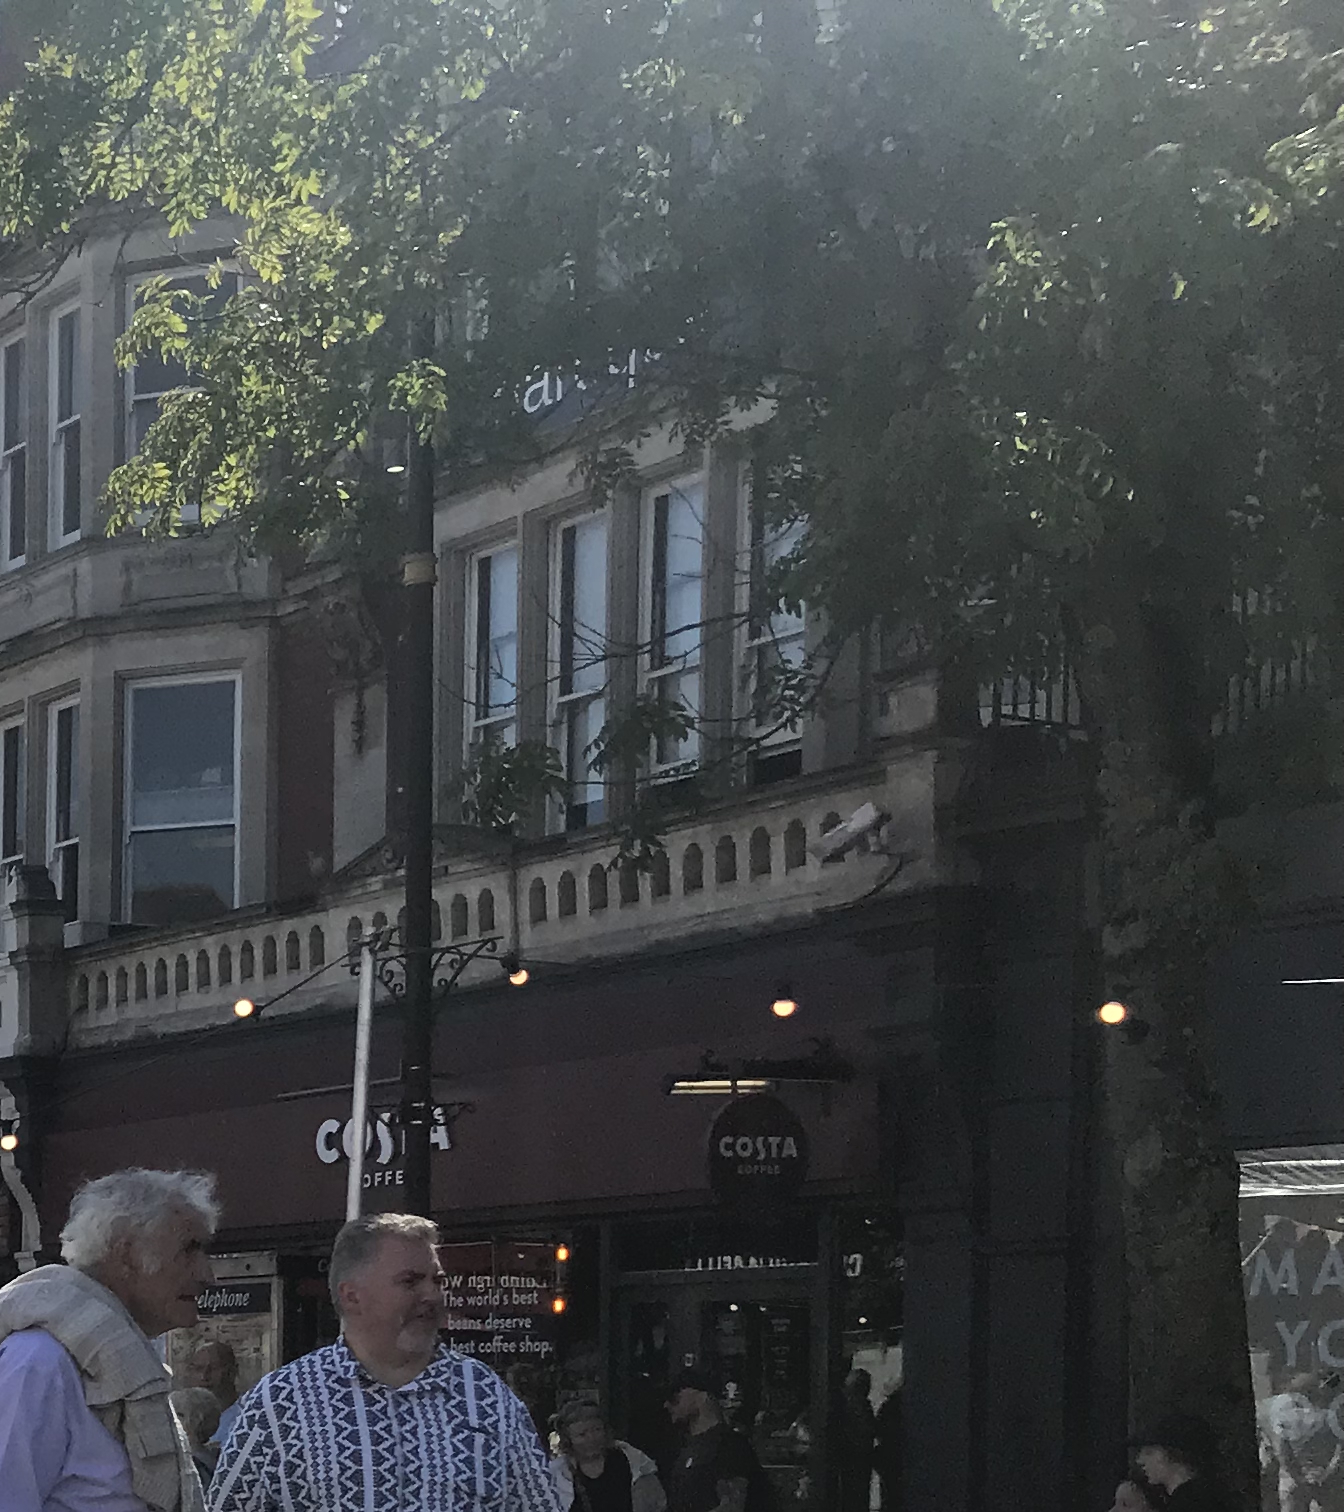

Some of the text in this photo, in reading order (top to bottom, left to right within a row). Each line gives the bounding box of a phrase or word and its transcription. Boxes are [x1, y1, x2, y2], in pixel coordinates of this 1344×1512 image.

[316, 1112, 451, 1165] COSA
[719, 1135, 798, 1160] COSTA
[737, 1164, 781, 1175] COFFEE
[196, 1288, 251, 1312] elephone
[467, 1288, 509, 1306] world's
[512, 1290, 539, 1305] best
[447, 1313, 533, 1331] beans deserve
[478, 1335, 516, 1353] coffee
